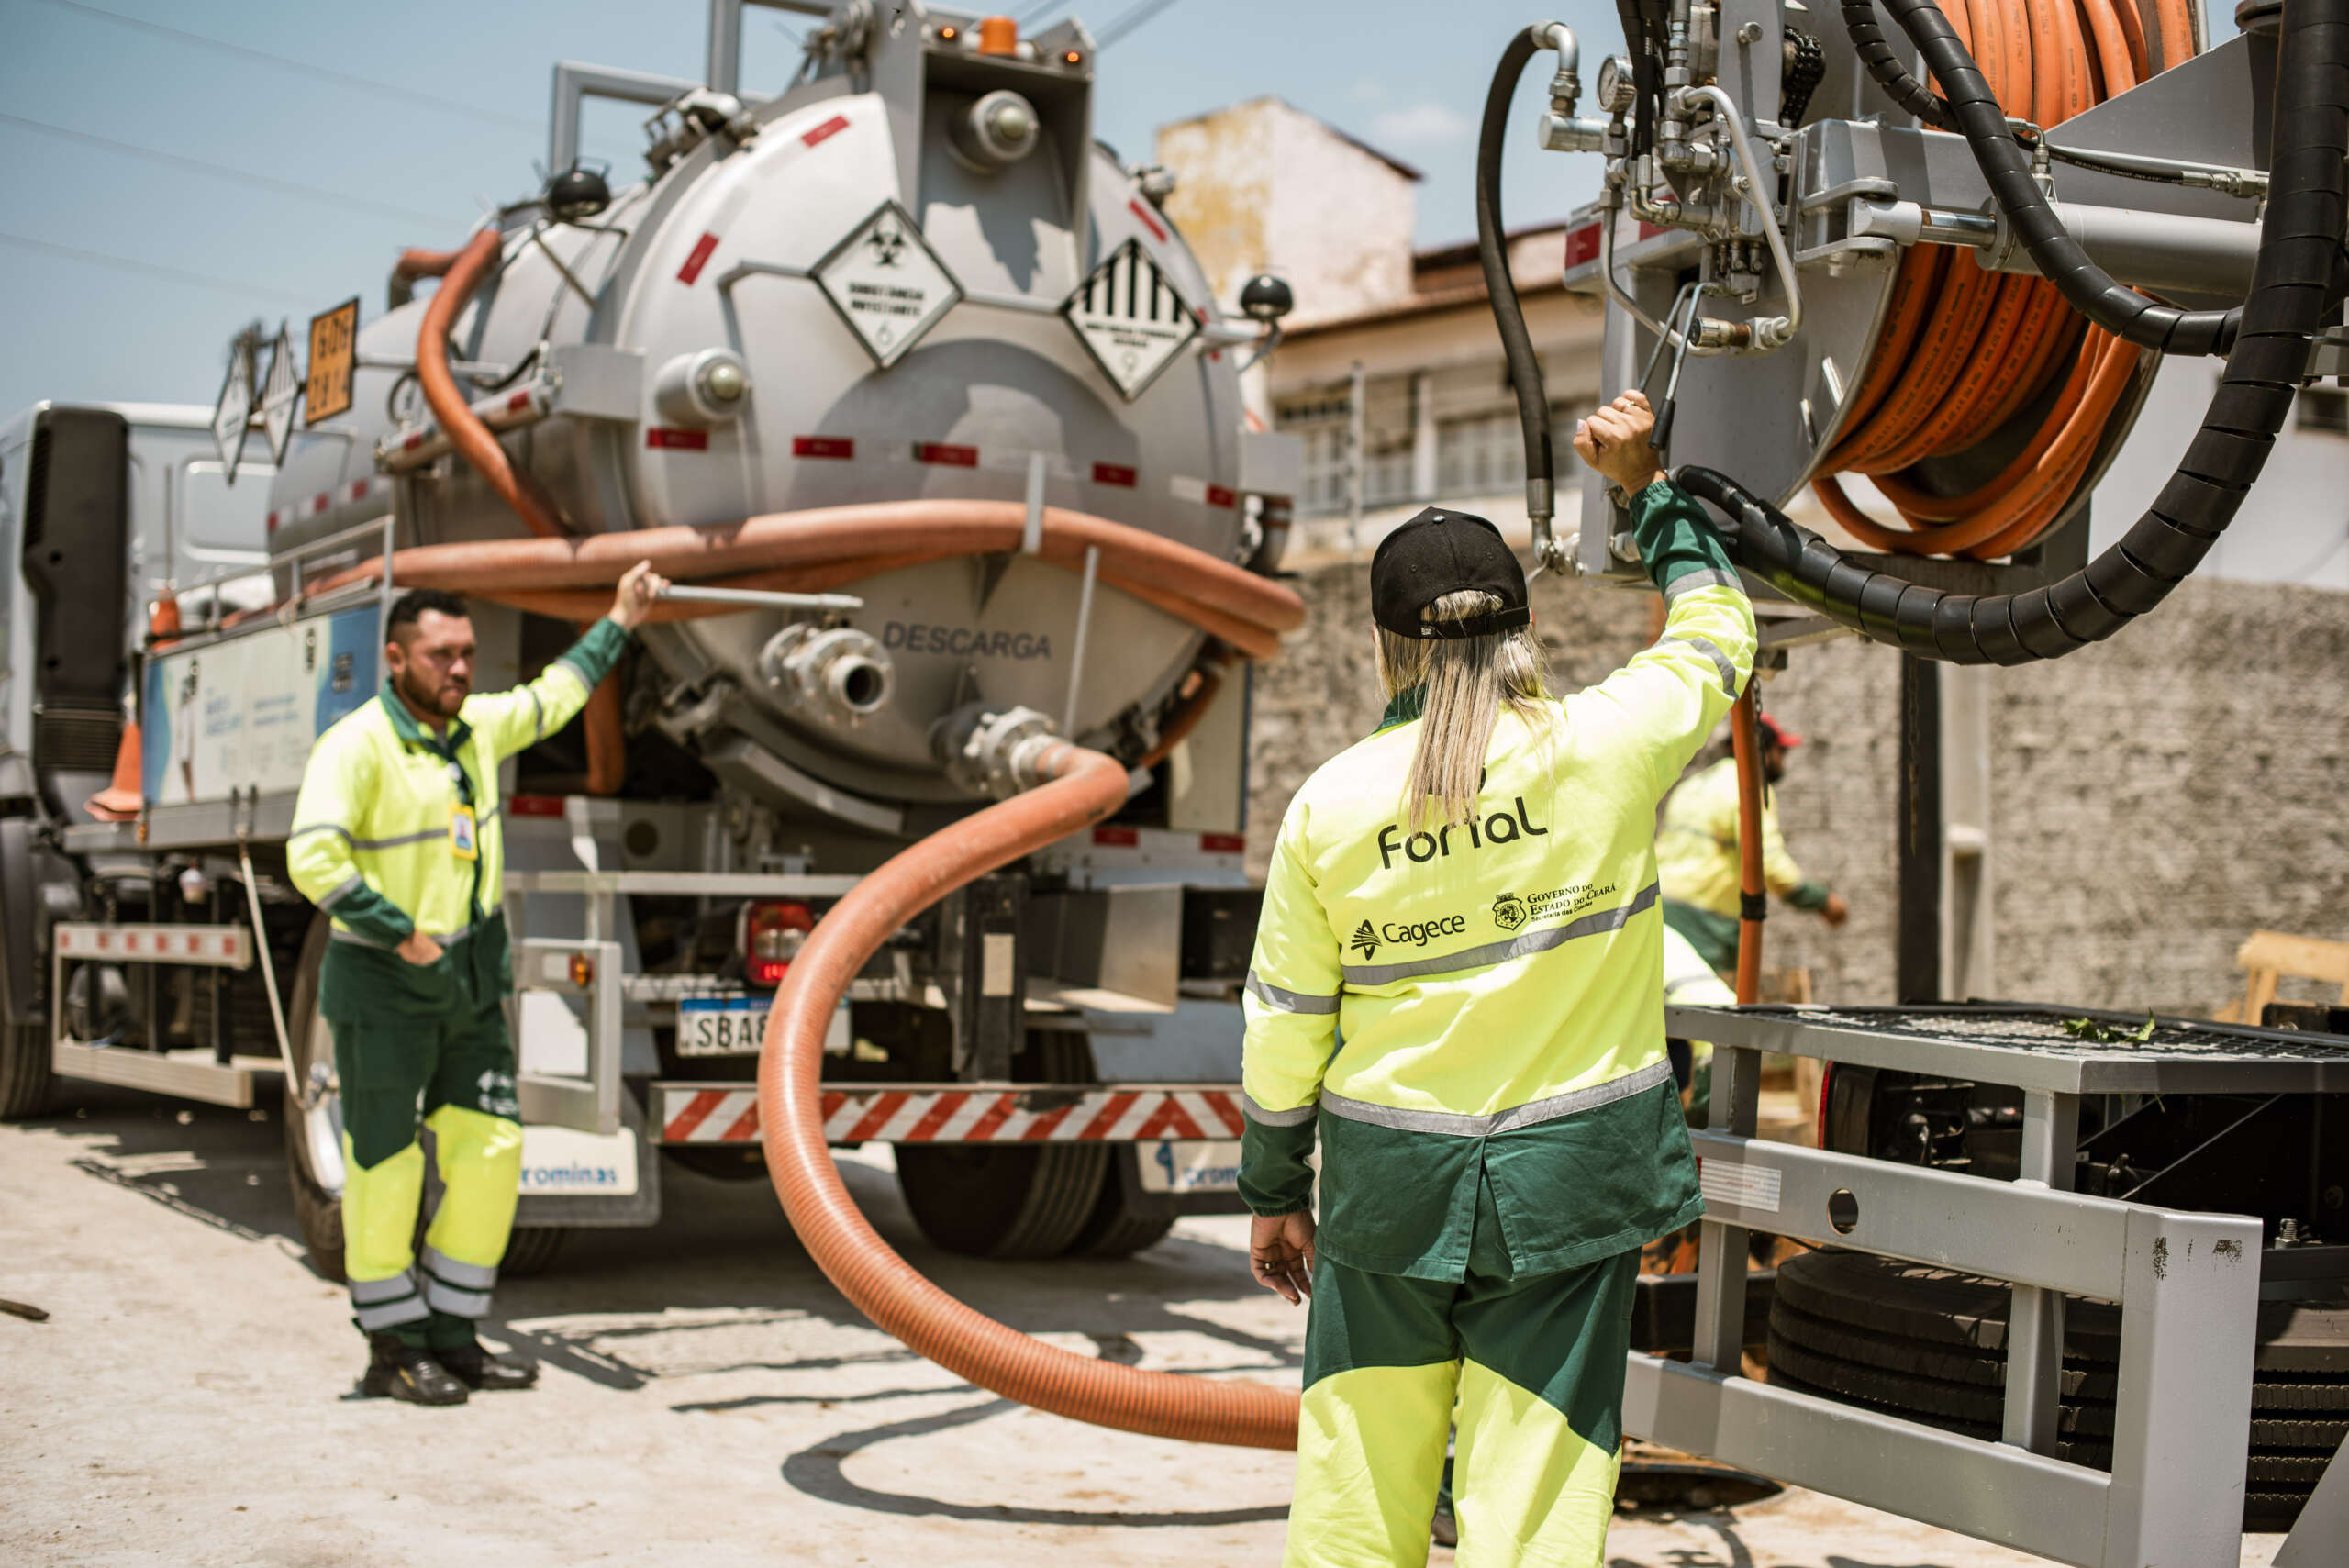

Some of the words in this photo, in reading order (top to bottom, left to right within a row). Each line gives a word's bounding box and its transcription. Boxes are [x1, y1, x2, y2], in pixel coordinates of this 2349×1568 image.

[882, 619, 1052, 661] DESCARGA
[1529, 899, 1571, 916] ESTADO
[1531, 911, 1561, 923] Secretaria
[1381, 915, 1466, 947] Cagece
[521, 1159, 618, 1184] rominas
